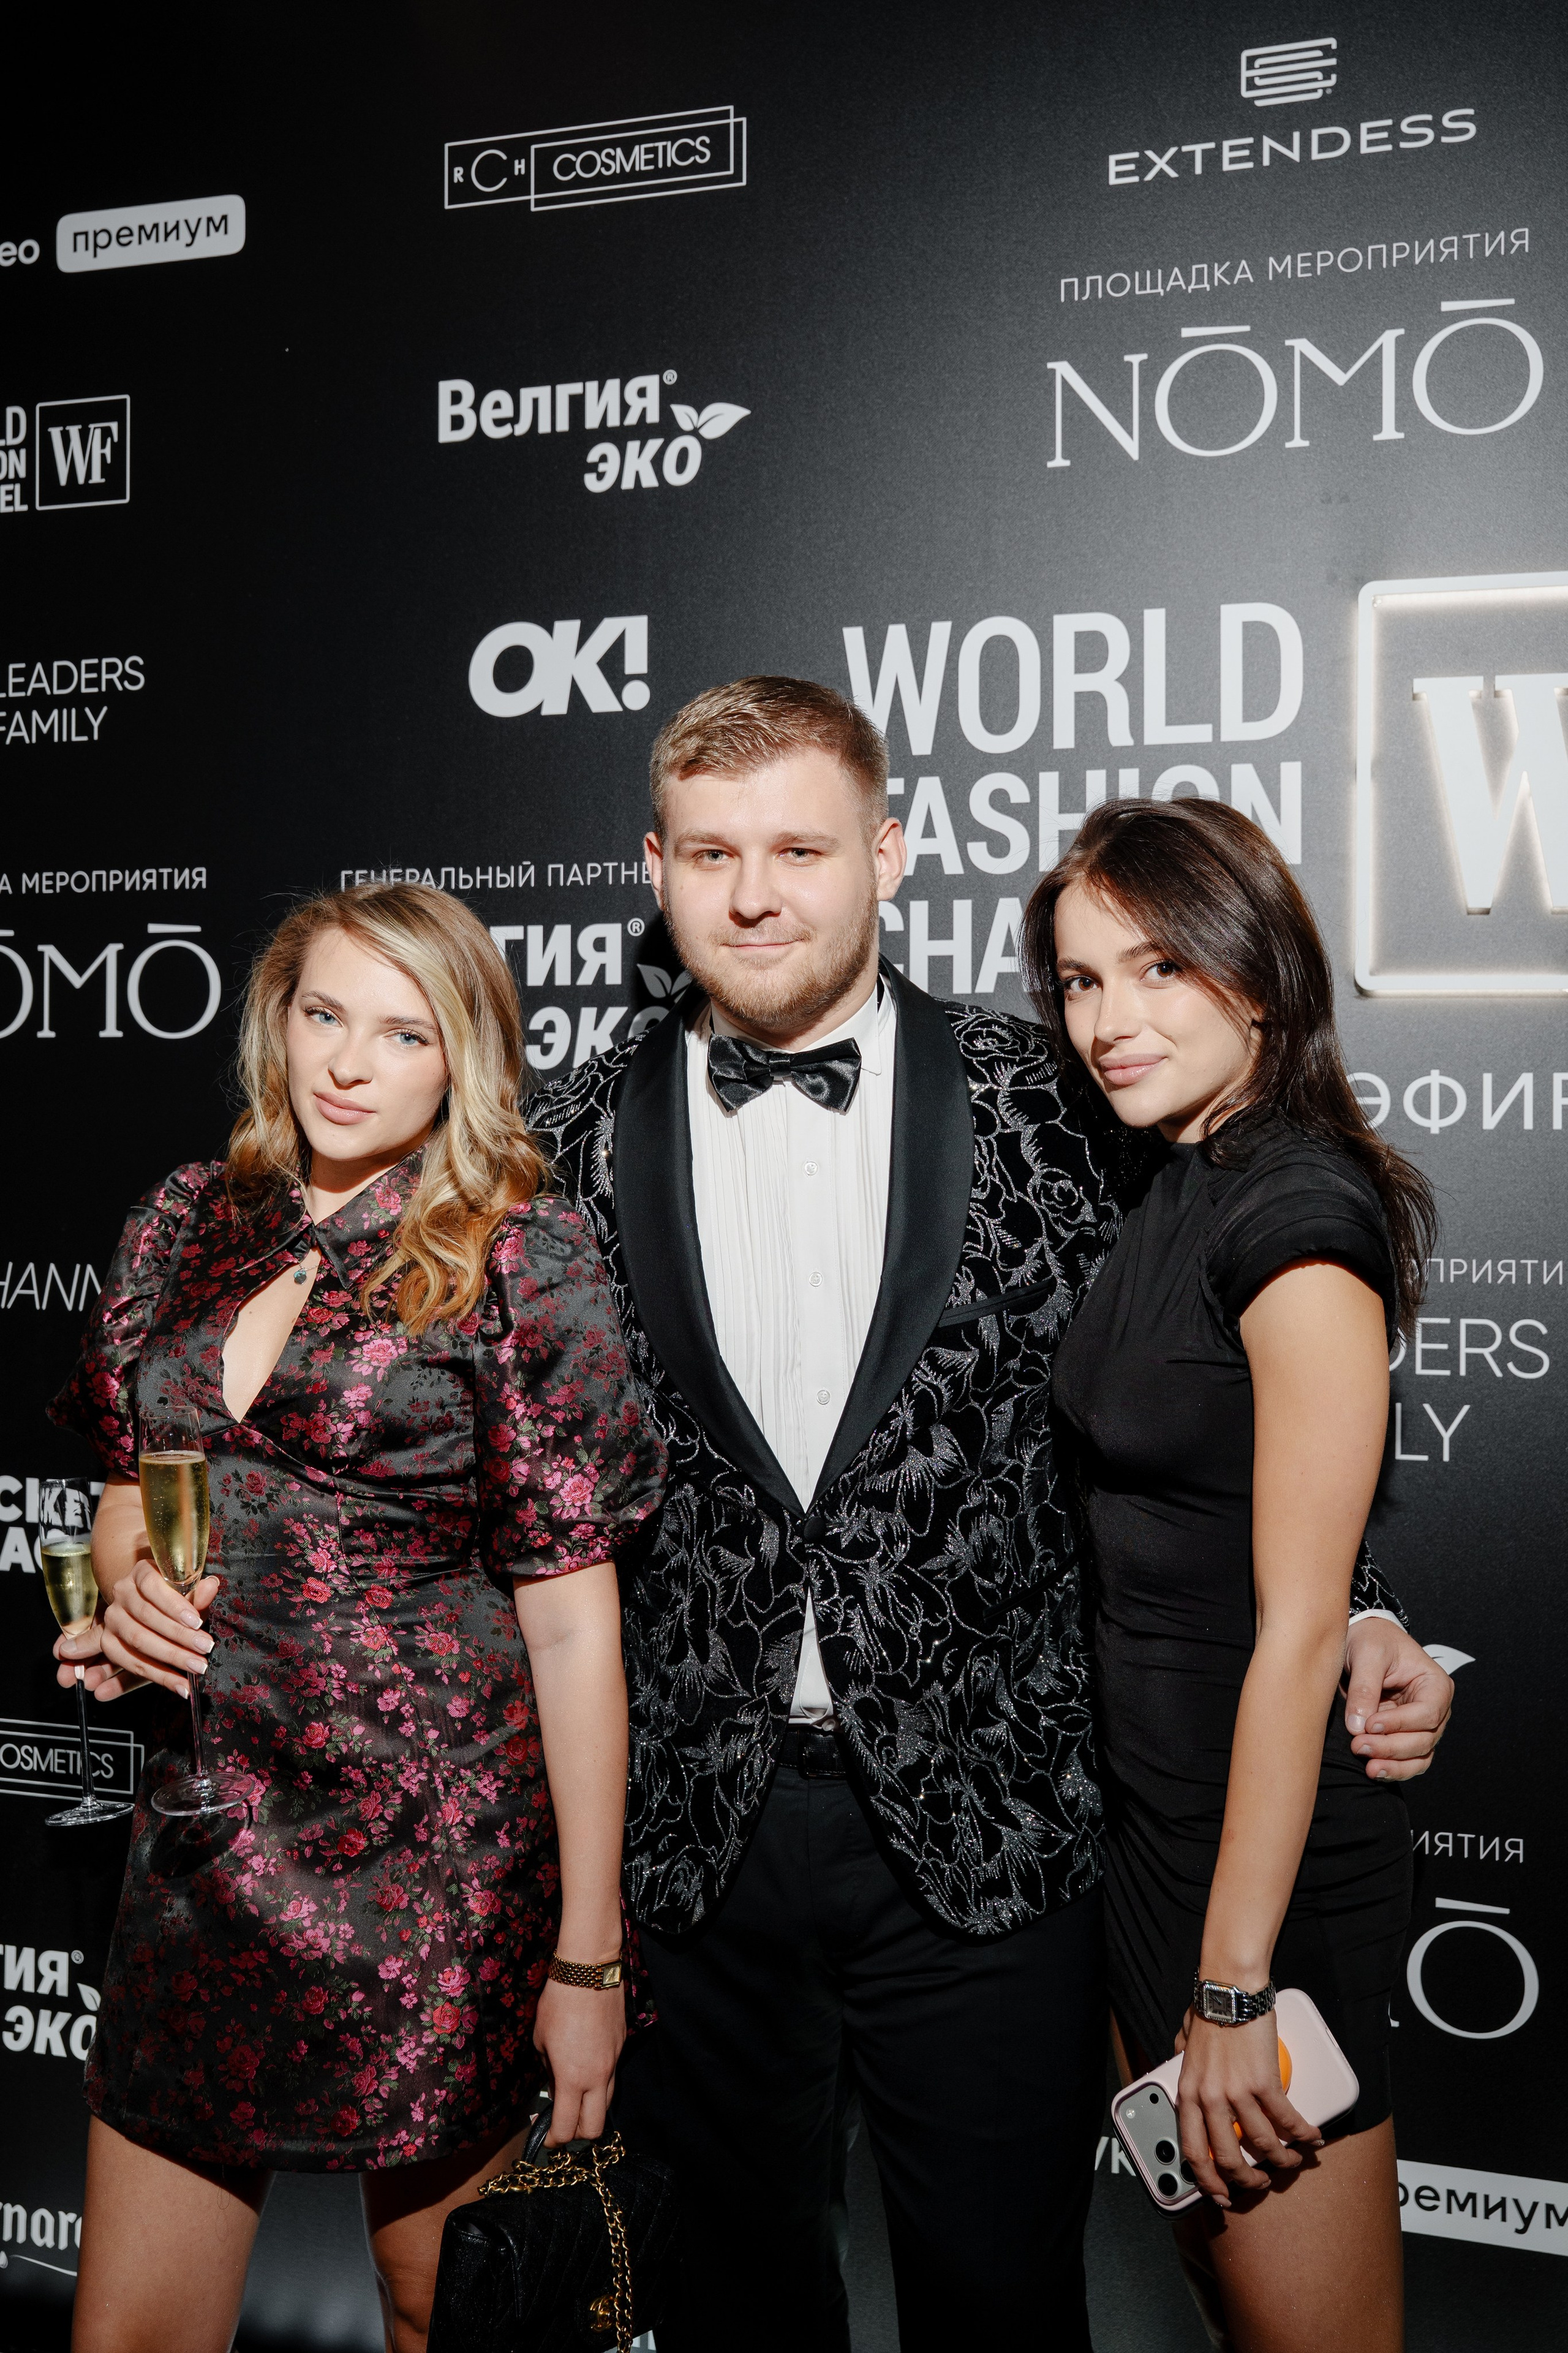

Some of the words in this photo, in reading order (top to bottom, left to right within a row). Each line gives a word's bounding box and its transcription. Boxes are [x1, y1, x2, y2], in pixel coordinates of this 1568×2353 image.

[552, 136, 711, 181] COSMETICS
[1109, 108, 1477, 186] EXTENDESS
[72, 213, 229, 259] премиум
[1060, 259, 1254, 303] ПЛОЩАДКА
[1268, 228, 1529, 281] МЕРОПРИЯТИЯ
[47, 421, 118, 486] WF
[0, 655, 145, 698] EADERS
[468, 614, 650, 718] OK!
[842, 602, 1304, 756] WORLD
[888, 760, 1302, 876] ASHN
[21, 867, 206, 894] МЕРОПРИЯТИЯ
